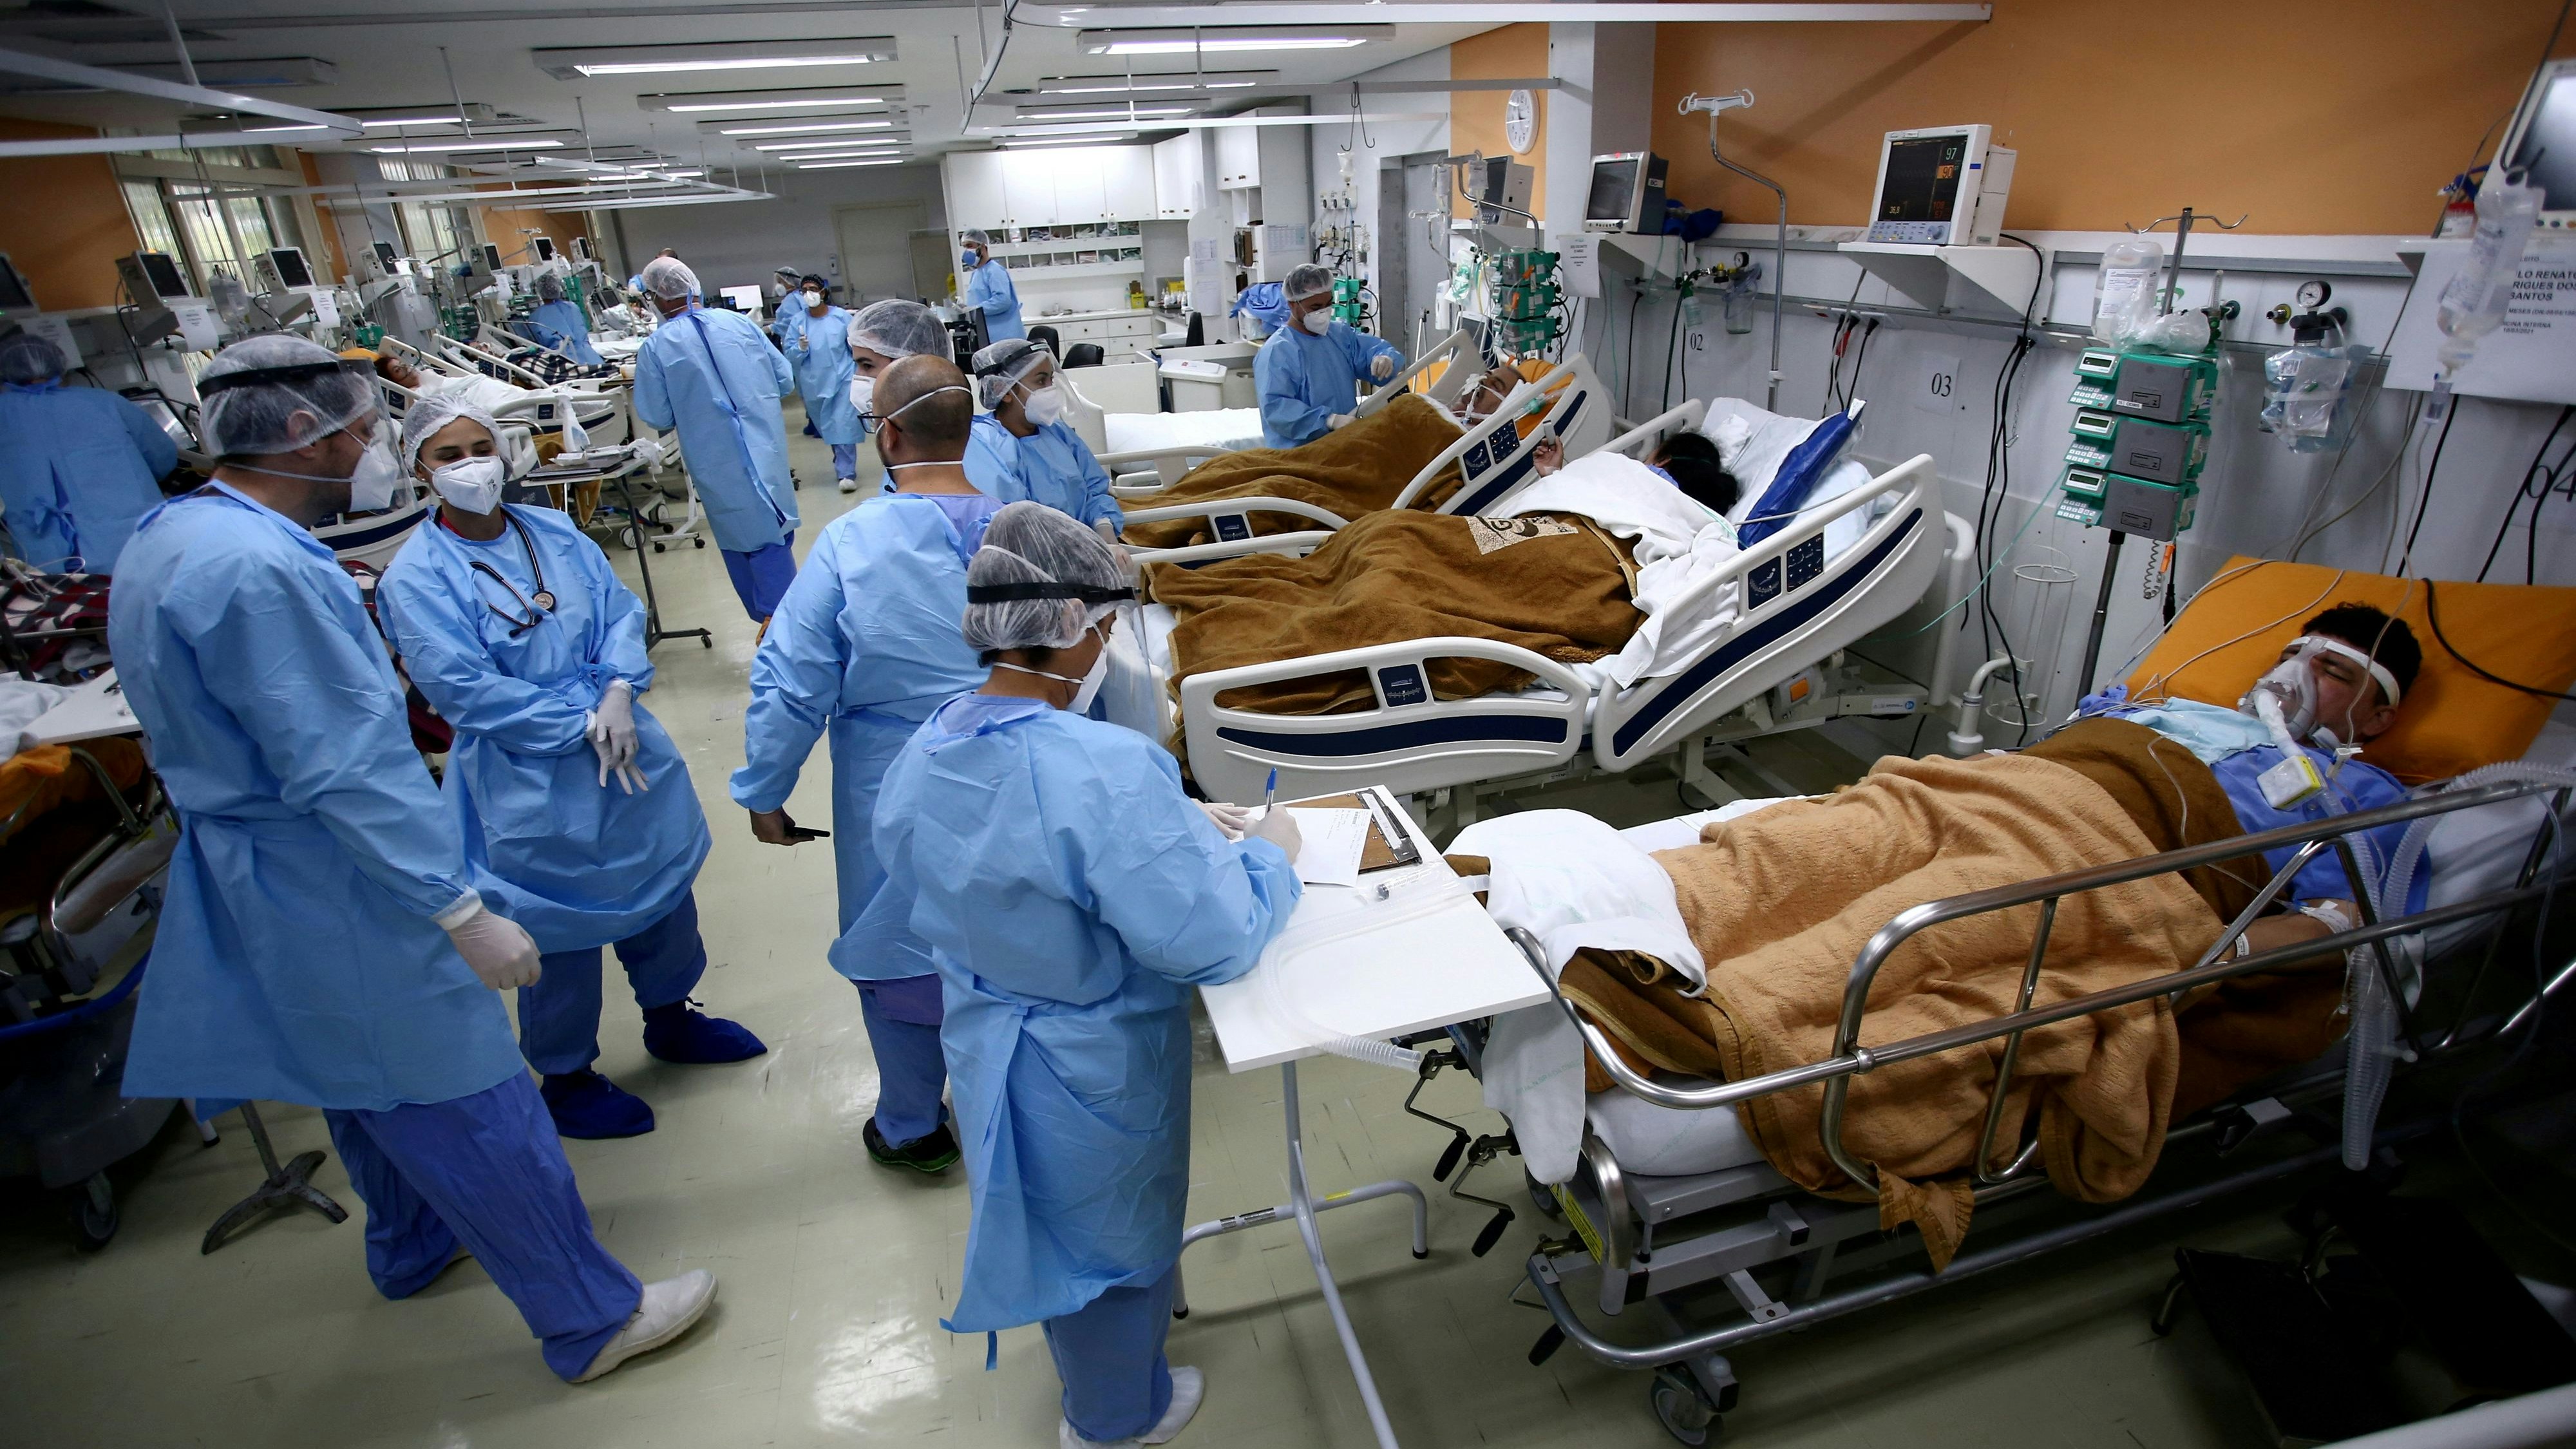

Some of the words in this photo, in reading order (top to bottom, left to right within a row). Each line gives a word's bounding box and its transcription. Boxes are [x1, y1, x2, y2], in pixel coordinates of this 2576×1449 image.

[1946, 147, 1957, 160] 97
[1942, 166, 1953, 178] 90
[1690, 333, 1703, 351] 02
[1931, 373, 1951, 397] 03
